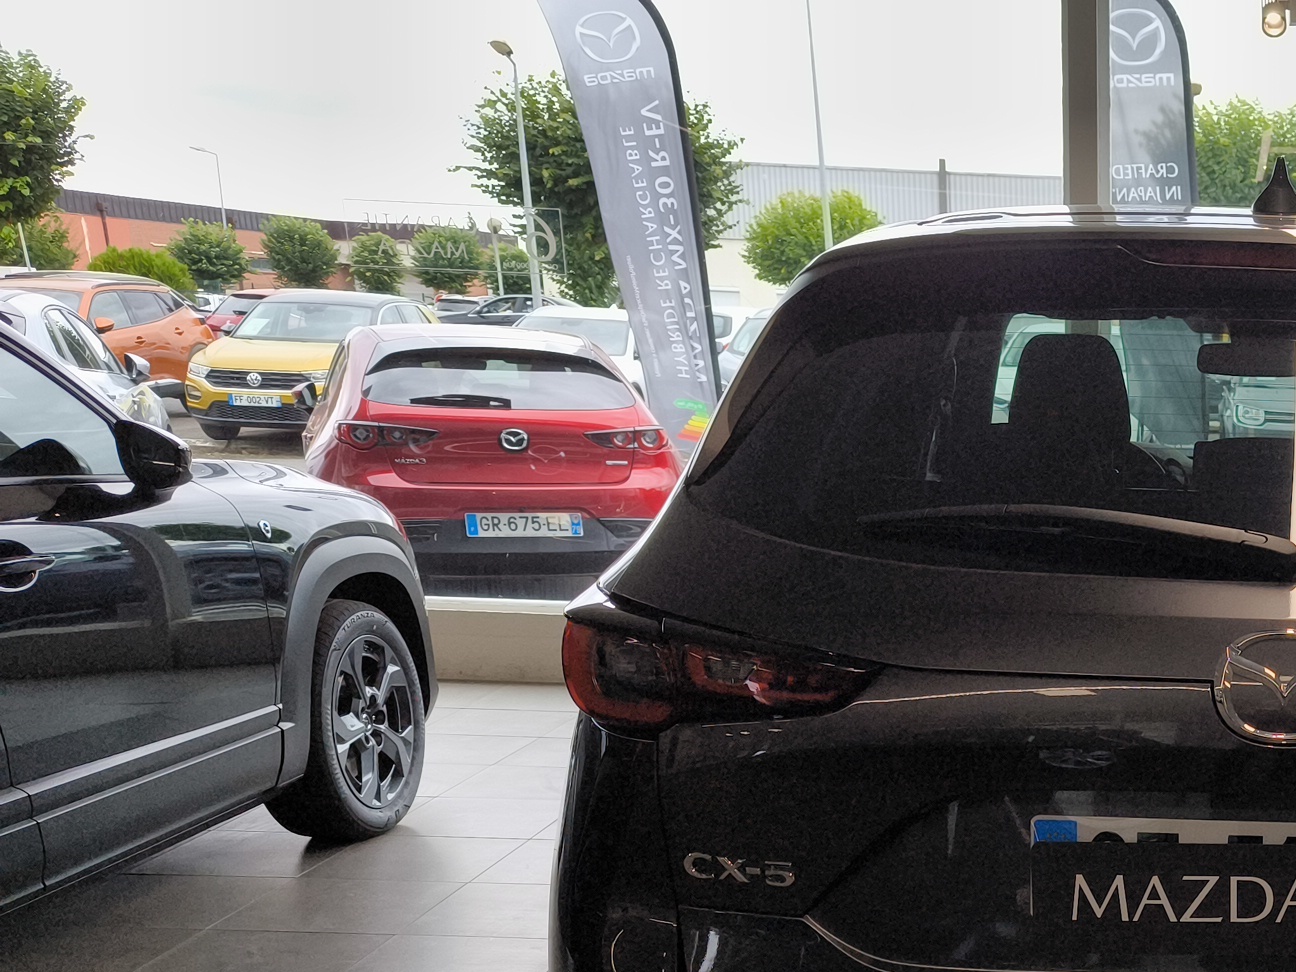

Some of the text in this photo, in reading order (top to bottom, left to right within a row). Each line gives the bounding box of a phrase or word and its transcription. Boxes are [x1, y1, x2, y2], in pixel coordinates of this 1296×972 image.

[480, 516, 569, 532] GR-675-EL
[342, 612, 376, 633] TURANZA
[683, 852, 795, 887] CX-5
